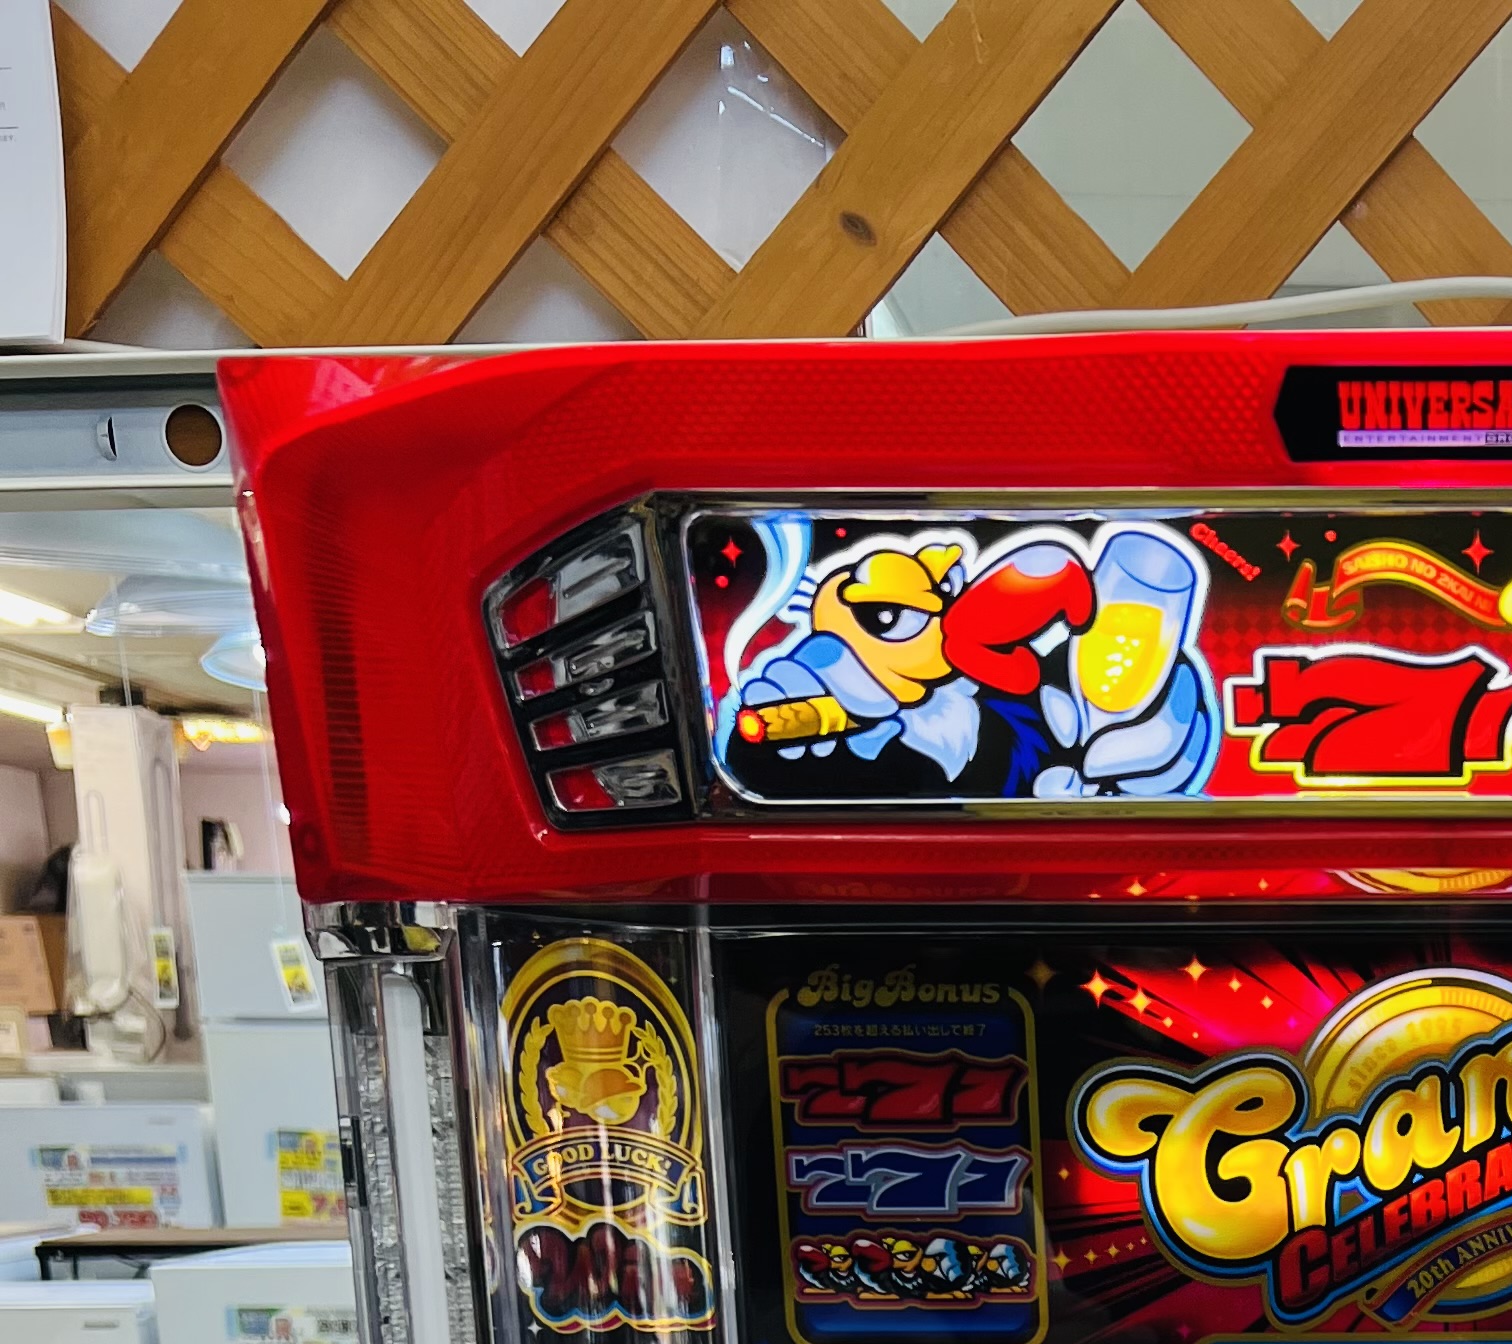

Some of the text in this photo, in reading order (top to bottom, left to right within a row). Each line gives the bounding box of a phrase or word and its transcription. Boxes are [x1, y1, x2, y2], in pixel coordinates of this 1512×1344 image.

[1343, 433, 1484, 444] ENTERTAINMENT
[1410, 559, 1437, 580] NO
[532, 1143, 595, 1178] GOOD
[1407, 1257, 1456, 1299] 20th
